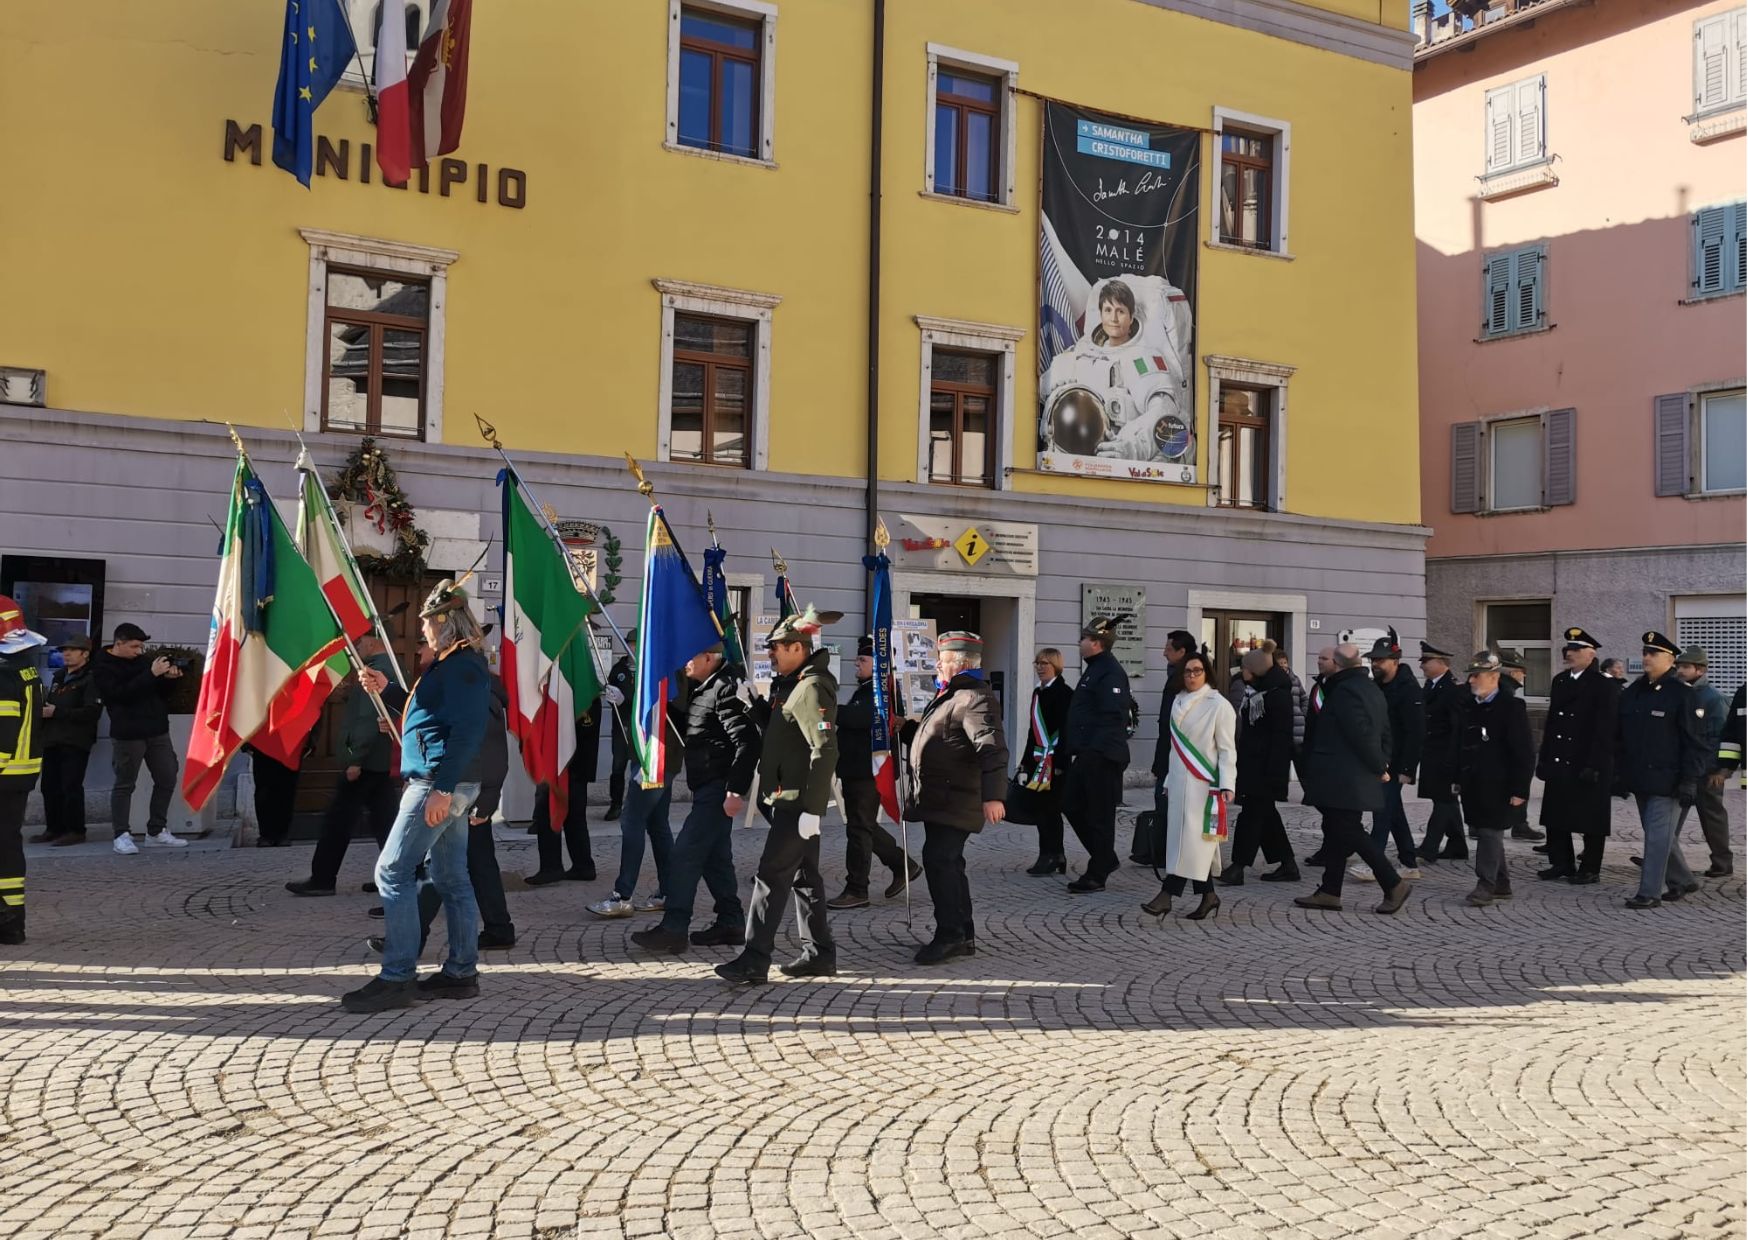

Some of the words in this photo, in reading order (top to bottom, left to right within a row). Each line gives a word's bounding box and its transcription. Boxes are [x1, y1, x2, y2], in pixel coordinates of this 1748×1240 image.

[1092, 126, 1144, 145] SAMANTHA
[224, 119, 527, 209] MNIIPIO
[1092, 142, 1167, 165] CRISTOFORETTI
[1096, 243, 1145, 262] MALÉ
[965, 534, 977, 557] i
[488, 581, 499, 590] 17
[878, 627, 888, 657] CALDES
[880, 672, 888, 692] SOLE
